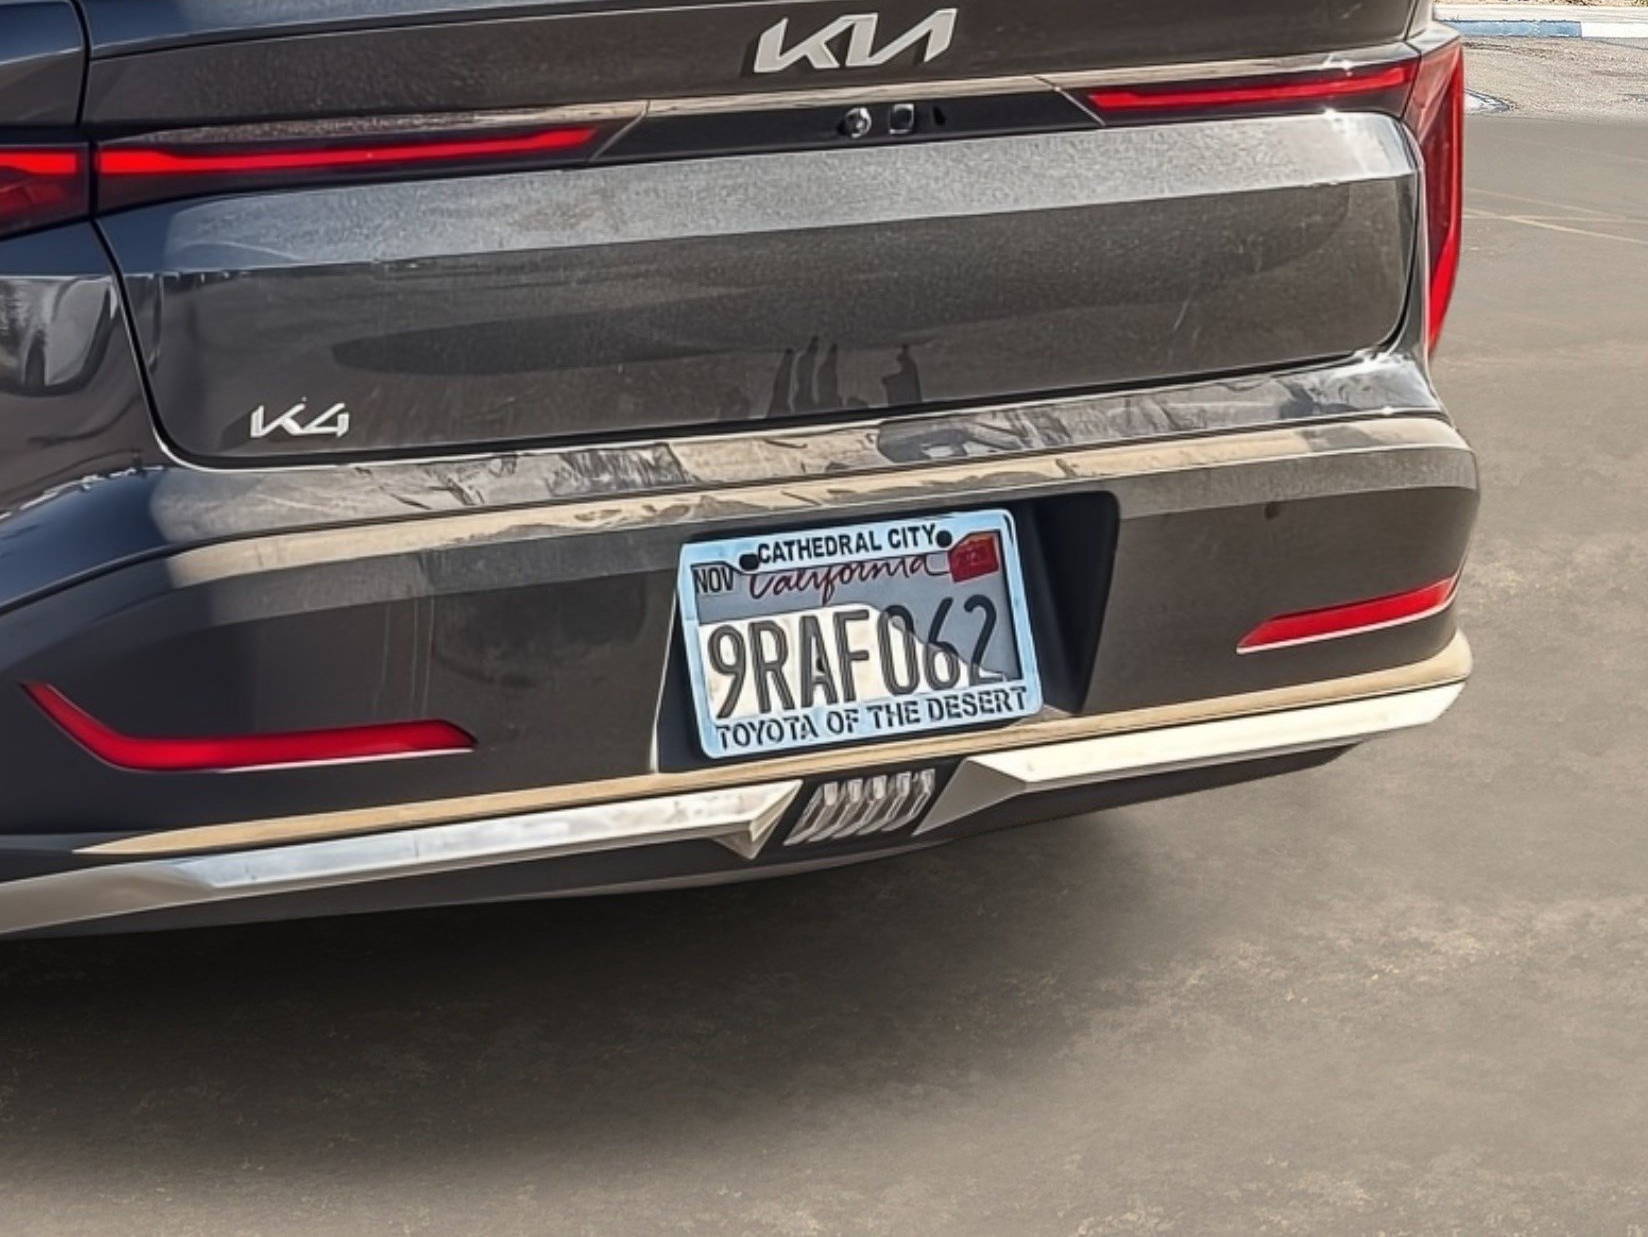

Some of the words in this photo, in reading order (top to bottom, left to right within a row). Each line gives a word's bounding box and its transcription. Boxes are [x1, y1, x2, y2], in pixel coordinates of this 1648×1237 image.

[753, 8, 958, 74] KIA
[250, 402, 350, 438] K4
[757, 530, 882, 564] CATHEDRAL
[887, 523, 936, 550] CITY
[694, 566, 734, 594] NOV
[707, 594, 1005, 720] 9RAF062
[716, 715, 819, 750] TOYOTA
[826, 708, 860, 736] OF
[865, 699, 922, 730] THE
[926, 685, 1028, 723] DESERT
